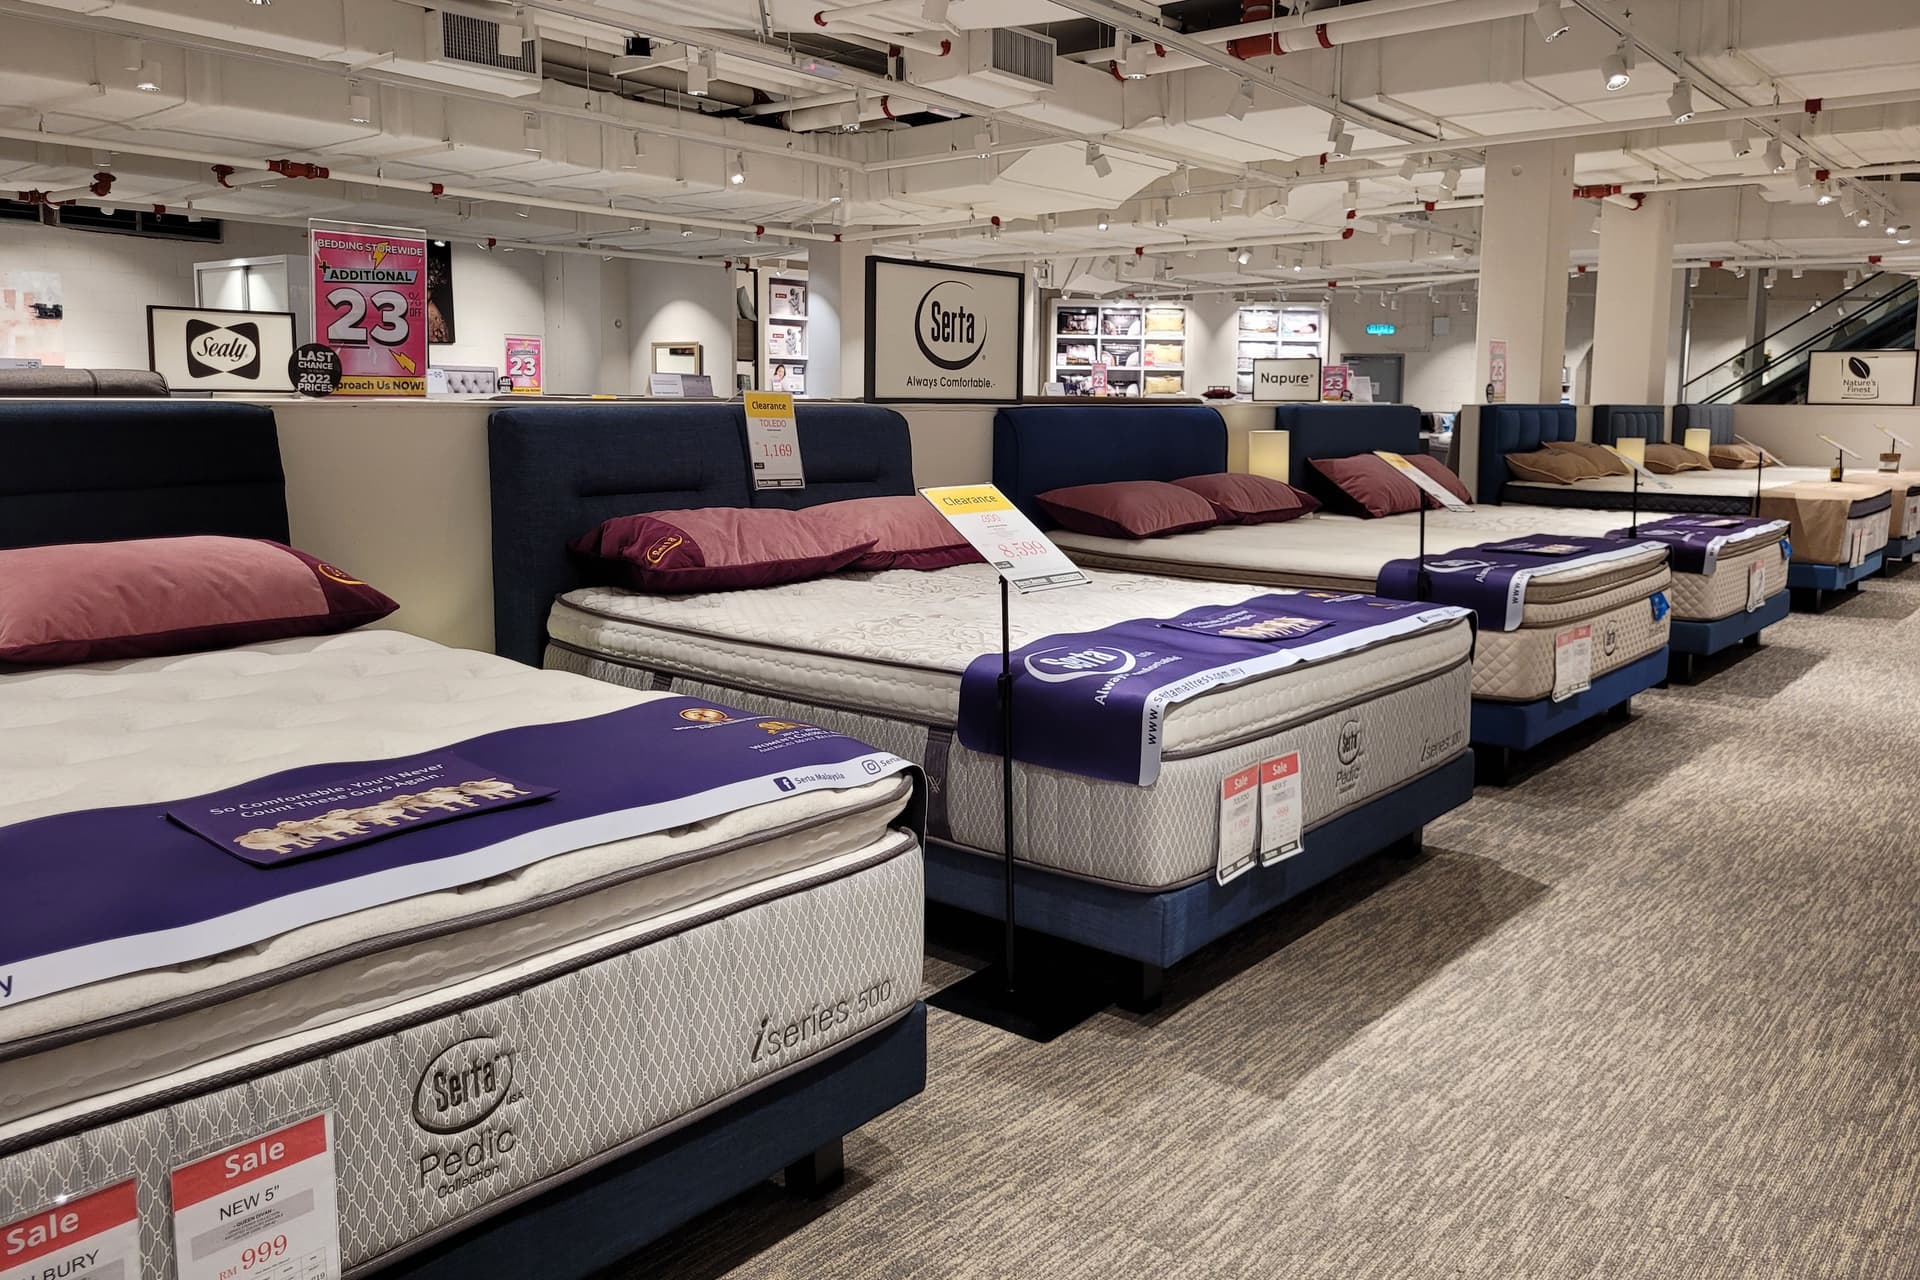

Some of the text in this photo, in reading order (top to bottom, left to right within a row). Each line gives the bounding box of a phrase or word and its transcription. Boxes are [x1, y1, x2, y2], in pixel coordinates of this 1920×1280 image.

[317, 238, 423, 256] BEDDING STOREWIDE
[329, 269, 412, 282] ADDITIONAL
[409, 308, 423, 318] OFF
[931, 301, 975, 344] Serta
[196, 336, 248, 362] Sealy
[298, 350, 334, 362] LAST
[298, 361, 333, 370] CHANCE
[510, 357, 536, 376] 23
[300, 373, 331, 383] 2022
[906, 375, 938, 389] Always
[1261, 372, 1309, 387] Napure
[1325, 378, 1343, 390] 23
[297, 383, 334, 392] PRICES
[336, 381, 424, 392] proach Us NOW!
[751, 401, 787, 410] Clearance
[760, 419, 787, 428] TOLEDO
[763, 444, 793, 458] 1,169
[942, 495, 998, 506] Clearance
[998, 540, 1047, 559] 8,599
[1039, 648, 1118, 670] Serta
[1272, 761, 1288, 776] Sale
[794, 772, 845, 784] Serta Malaysia
[1234, 775, 1249, 790] Sale
[210, 763, 444, 815] So Comfortable, You'll Never
[240, 774, 445, 818] Count These Guys Again.
[858, 979, 892, 1013] 500
[433, 1060, 497, 1112] Serta
[225, 1141, 285, 1179] Sale
[420, 1128, 516, 1188] Pedic
[438, 1165, 500, 1198] Collection
[220, 1192, 260, 1221] NEW
[6, 1212, 80, 1256] Sale
[218, 1266, 238, 1280] RM
[241, 1234, 288, 1271] 999
